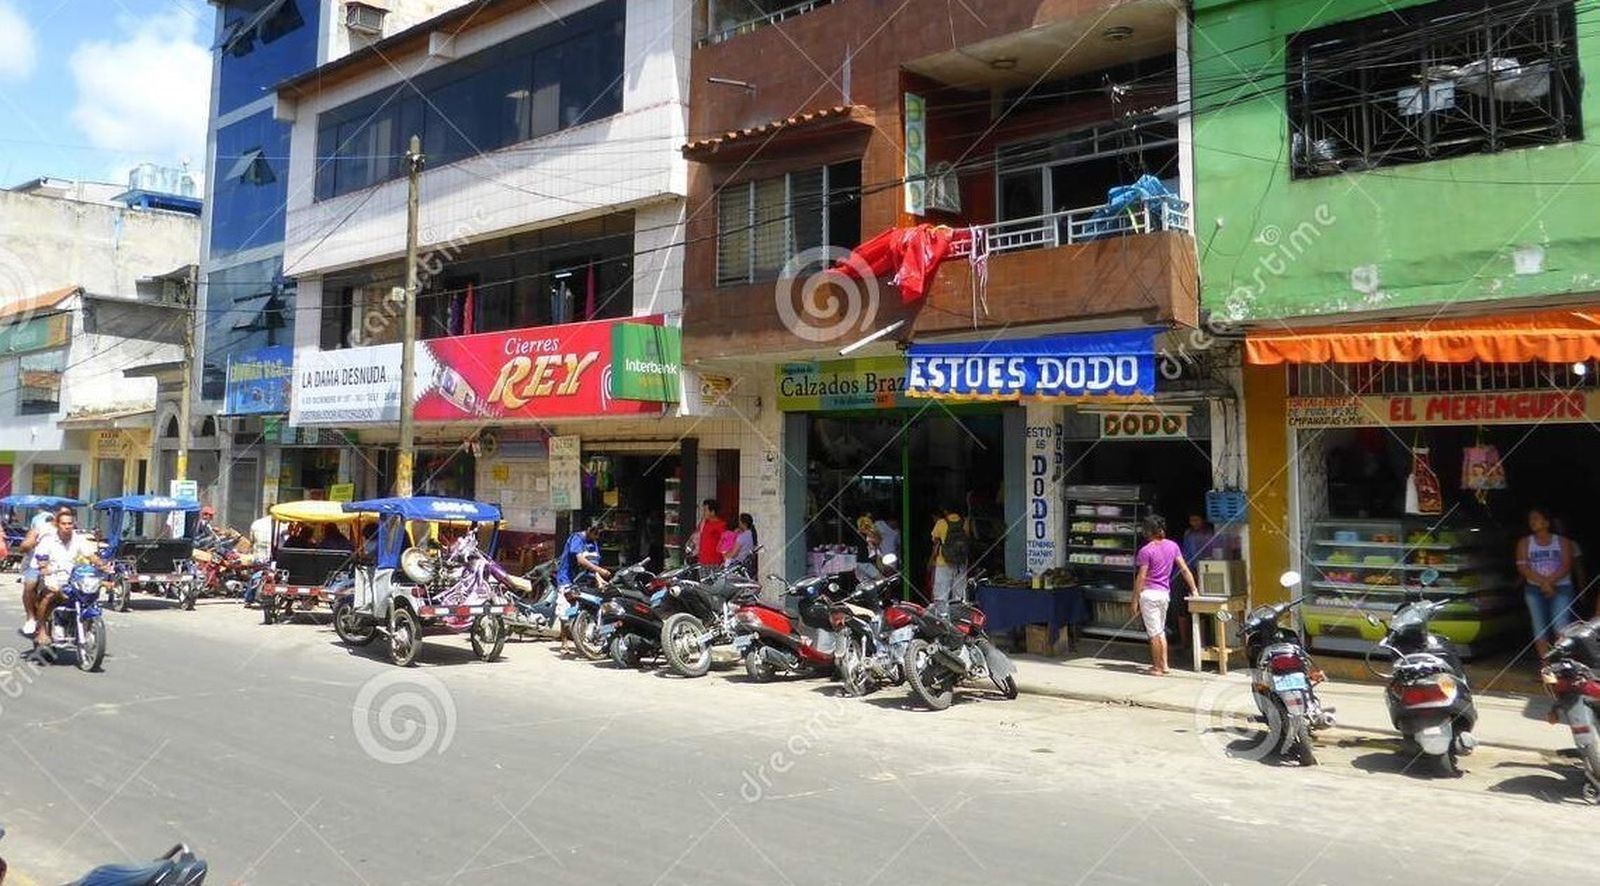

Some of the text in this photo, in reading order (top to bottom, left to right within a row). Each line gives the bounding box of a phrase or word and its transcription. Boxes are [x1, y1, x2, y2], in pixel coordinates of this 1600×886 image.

[505, 337, 560, 355] Cierres
[302, 371, 313, 389] LA
[314, 369, 339, 387] DAMA
[342, 364, 386, 386] DESNUDA
[625, 358, 680, 376] Interbank
[1036, 354, 1139, 388] DODO
[487, 351, 599, 410] REY
[780, 374, 860, 397] Calzados
[1389, 397, 1416, 421] EL
[1026, 427, 1051, 438] ESTO
[1104, 413, 1182, 436] DODO
[1031, 454, 1047, 540] DODO
